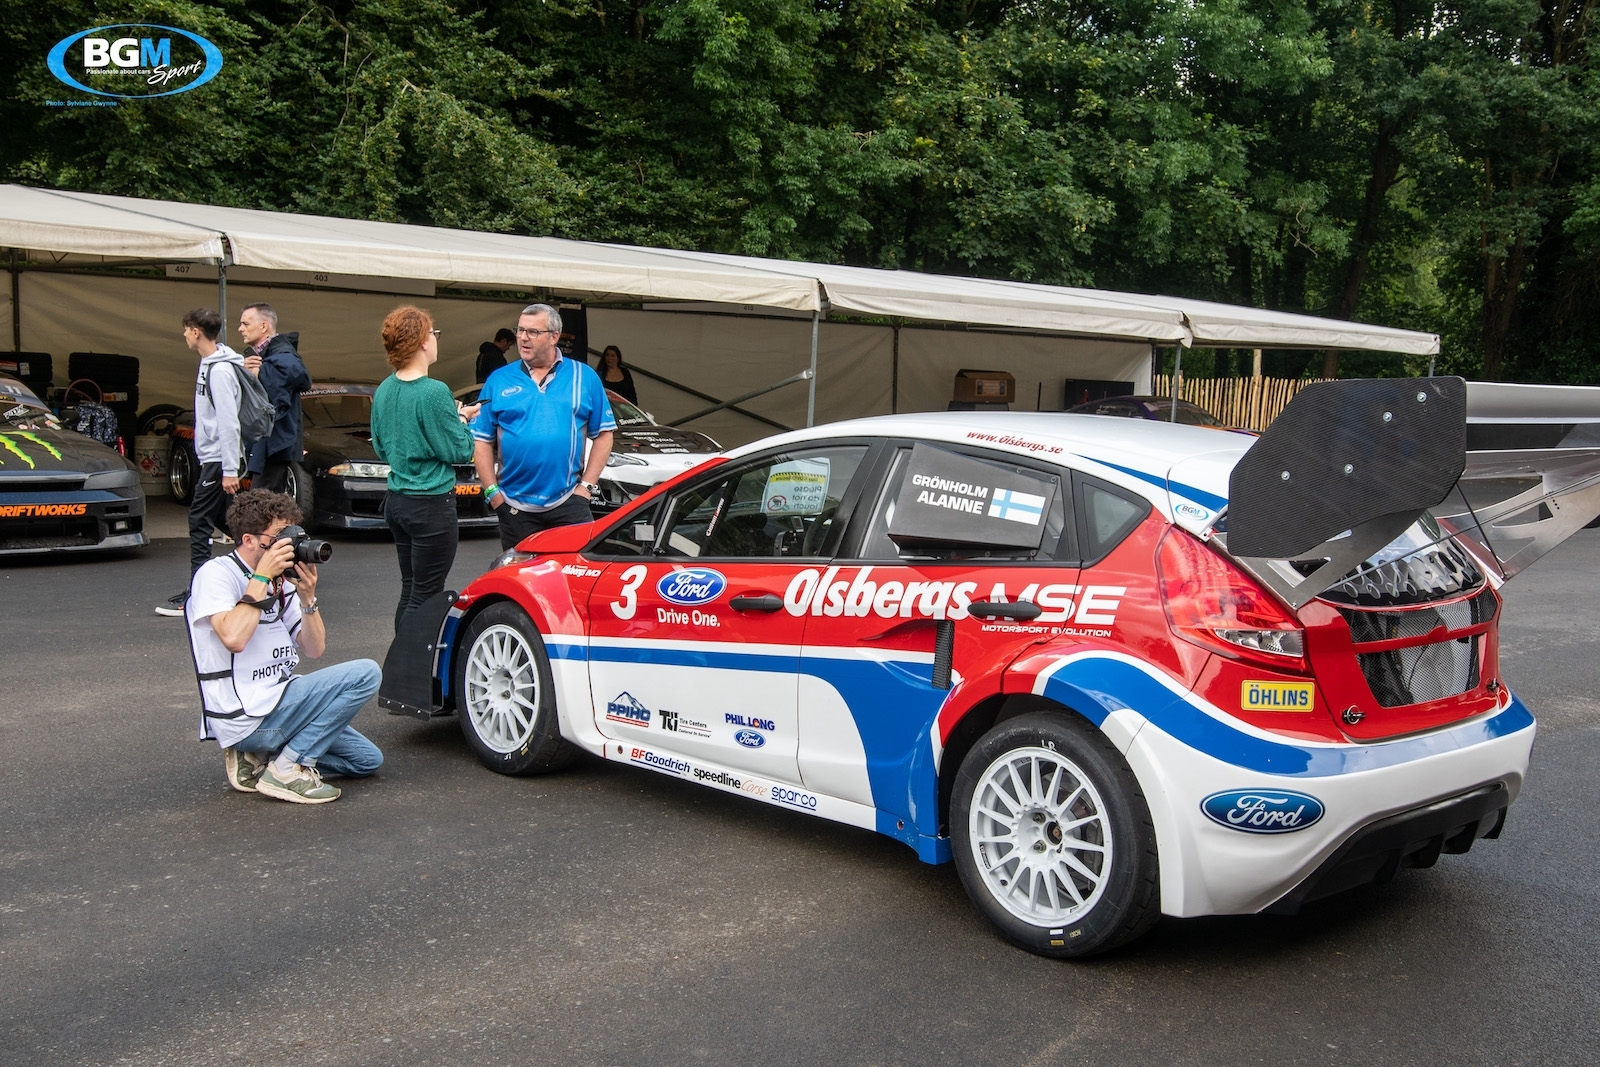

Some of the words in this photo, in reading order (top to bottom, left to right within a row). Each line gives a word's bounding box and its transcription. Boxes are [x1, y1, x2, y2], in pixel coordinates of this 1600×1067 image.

[314, 274, 328, 282] 403
[967, 431, 1063, 454] www.Olsbergs.se
[912, 474, 988, 498] GRÖNHOLM
[917, 491, 984, 515] ALANNE
[610, 565, 648, 620] 3
[667, 572, 715, 599] Ford
[784, 565, 978, 620] Olsbergs
[657, 607, 689, 625] Drive
[692, 609, 721, 627] One.
[981, 624, 1050, 634] MOTORSPORT
[1051, 626, 1112, 637] EVOLUTION
[1248, 684, 1309, 706] ÖHLINS
[689, 720, 708, 728] Centers
[725, 712, 746, 726] PHIL
[747, 717, 775, 731] LONG
[739, 731, 761, 747] Ford
[1041, 739, 1057, 751] LR
[630, 748, 690, 774] BFGoodrich
[771, 786, 817, 809] sparco
[1226, 795, 1305, 827] Ford
